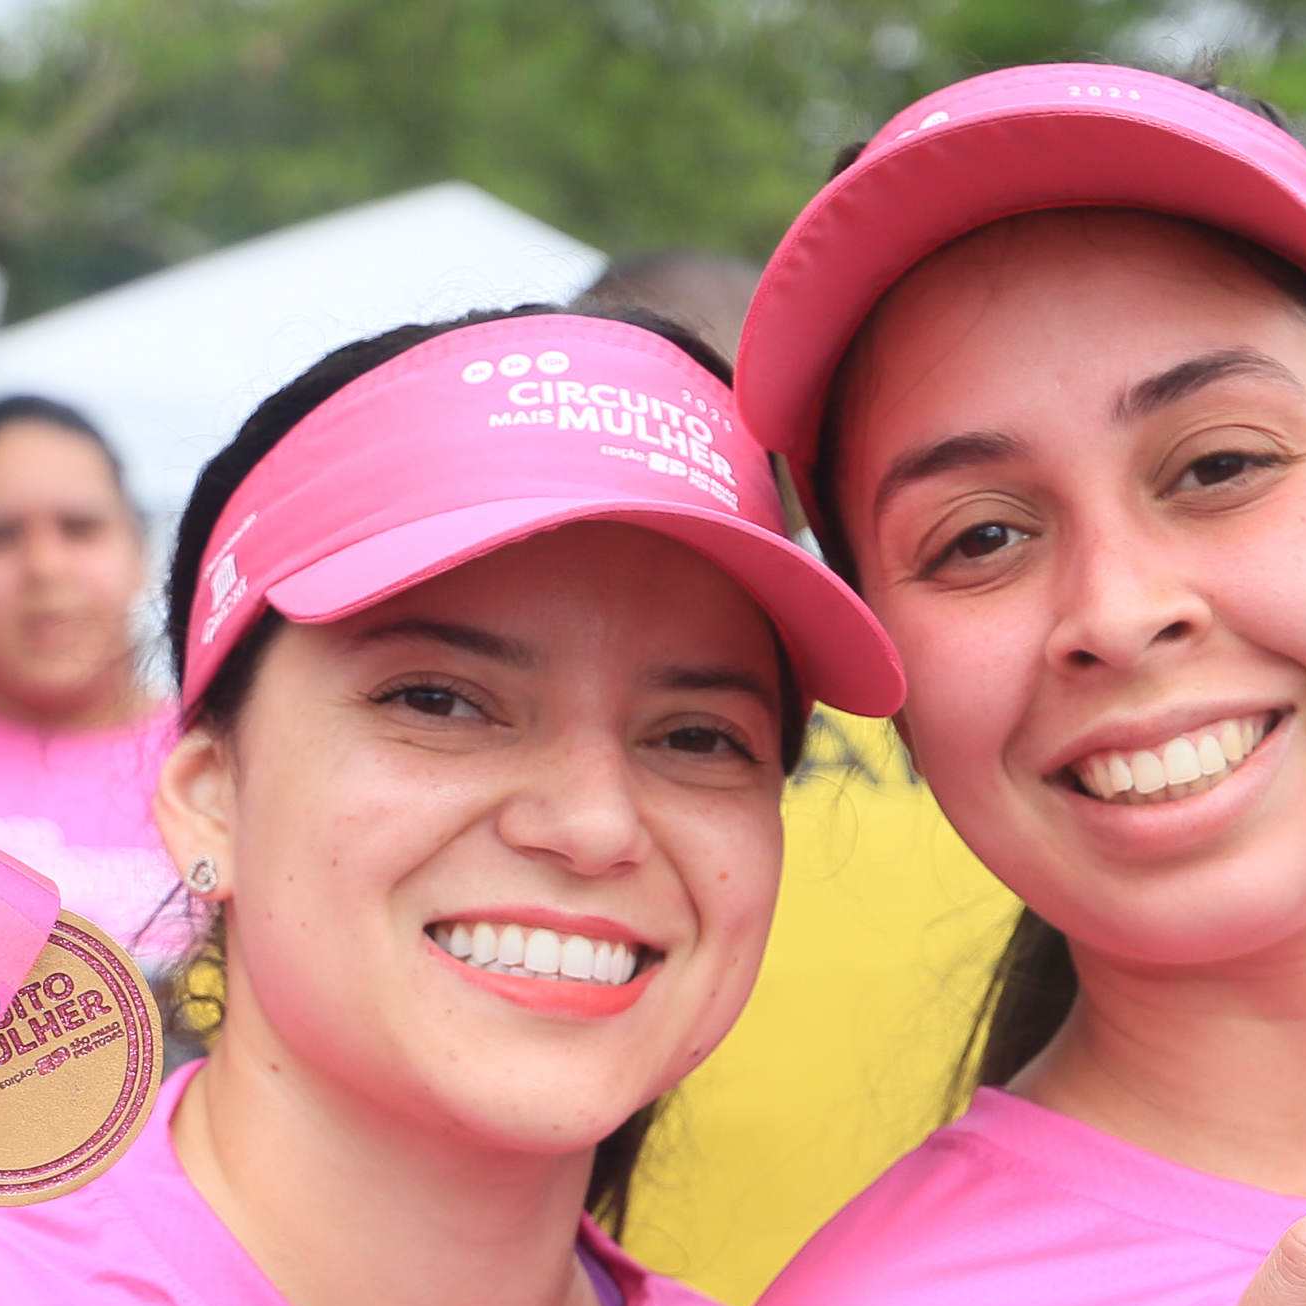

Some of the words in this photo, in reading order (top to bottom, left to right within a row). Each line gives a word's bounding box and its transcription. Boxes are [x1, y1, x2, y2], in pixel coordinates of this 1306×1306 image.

[1067, 84, 1141, 101] 2025
[508, 380, 714, 445] CIRCUITO
[489, 409, 556, 428] MAIS
[557, 405, 738, 487] MULHER
